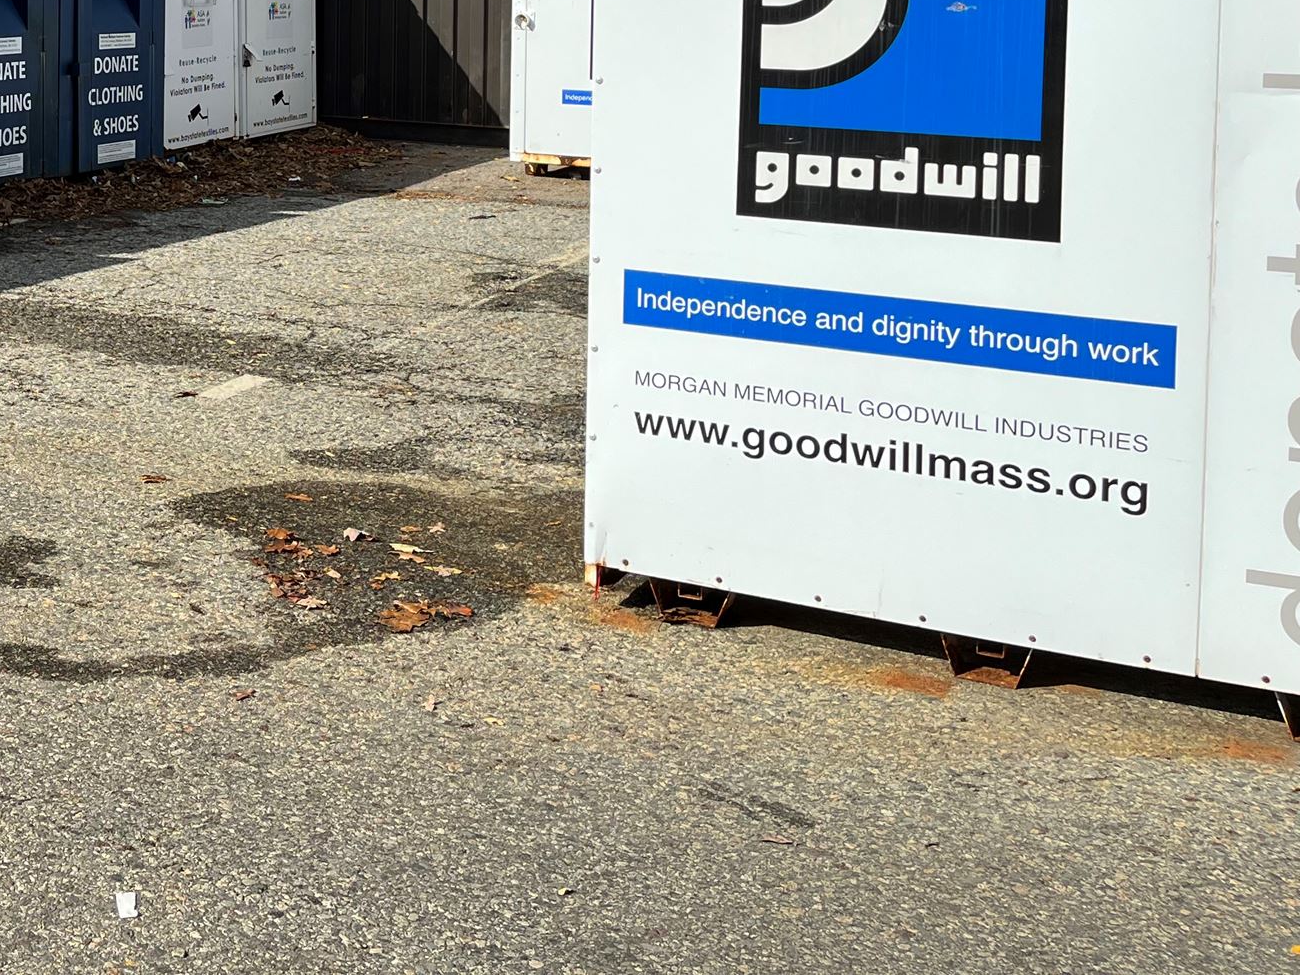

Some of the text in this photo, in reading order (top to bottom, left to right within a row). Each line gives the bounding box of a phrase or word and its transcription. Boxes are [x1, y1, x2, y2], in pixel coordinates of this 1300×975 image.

[94, 55, 138, 74] DONATE
[88, 84, 143, 105] CLOTHING
[170, 87, 192, 97] Violators
[93, 115, 138, 136] & SHOES
[754, 146, 1041, 204] goodwill
[636, 286, 1159, 367] Independence and dignity through work
[634, 370, 1149, 454] MORGAN MEMORIAL GOODWILL INDUSTRIES
[634, 409, 1149, 517] www.goodwillmass.org
